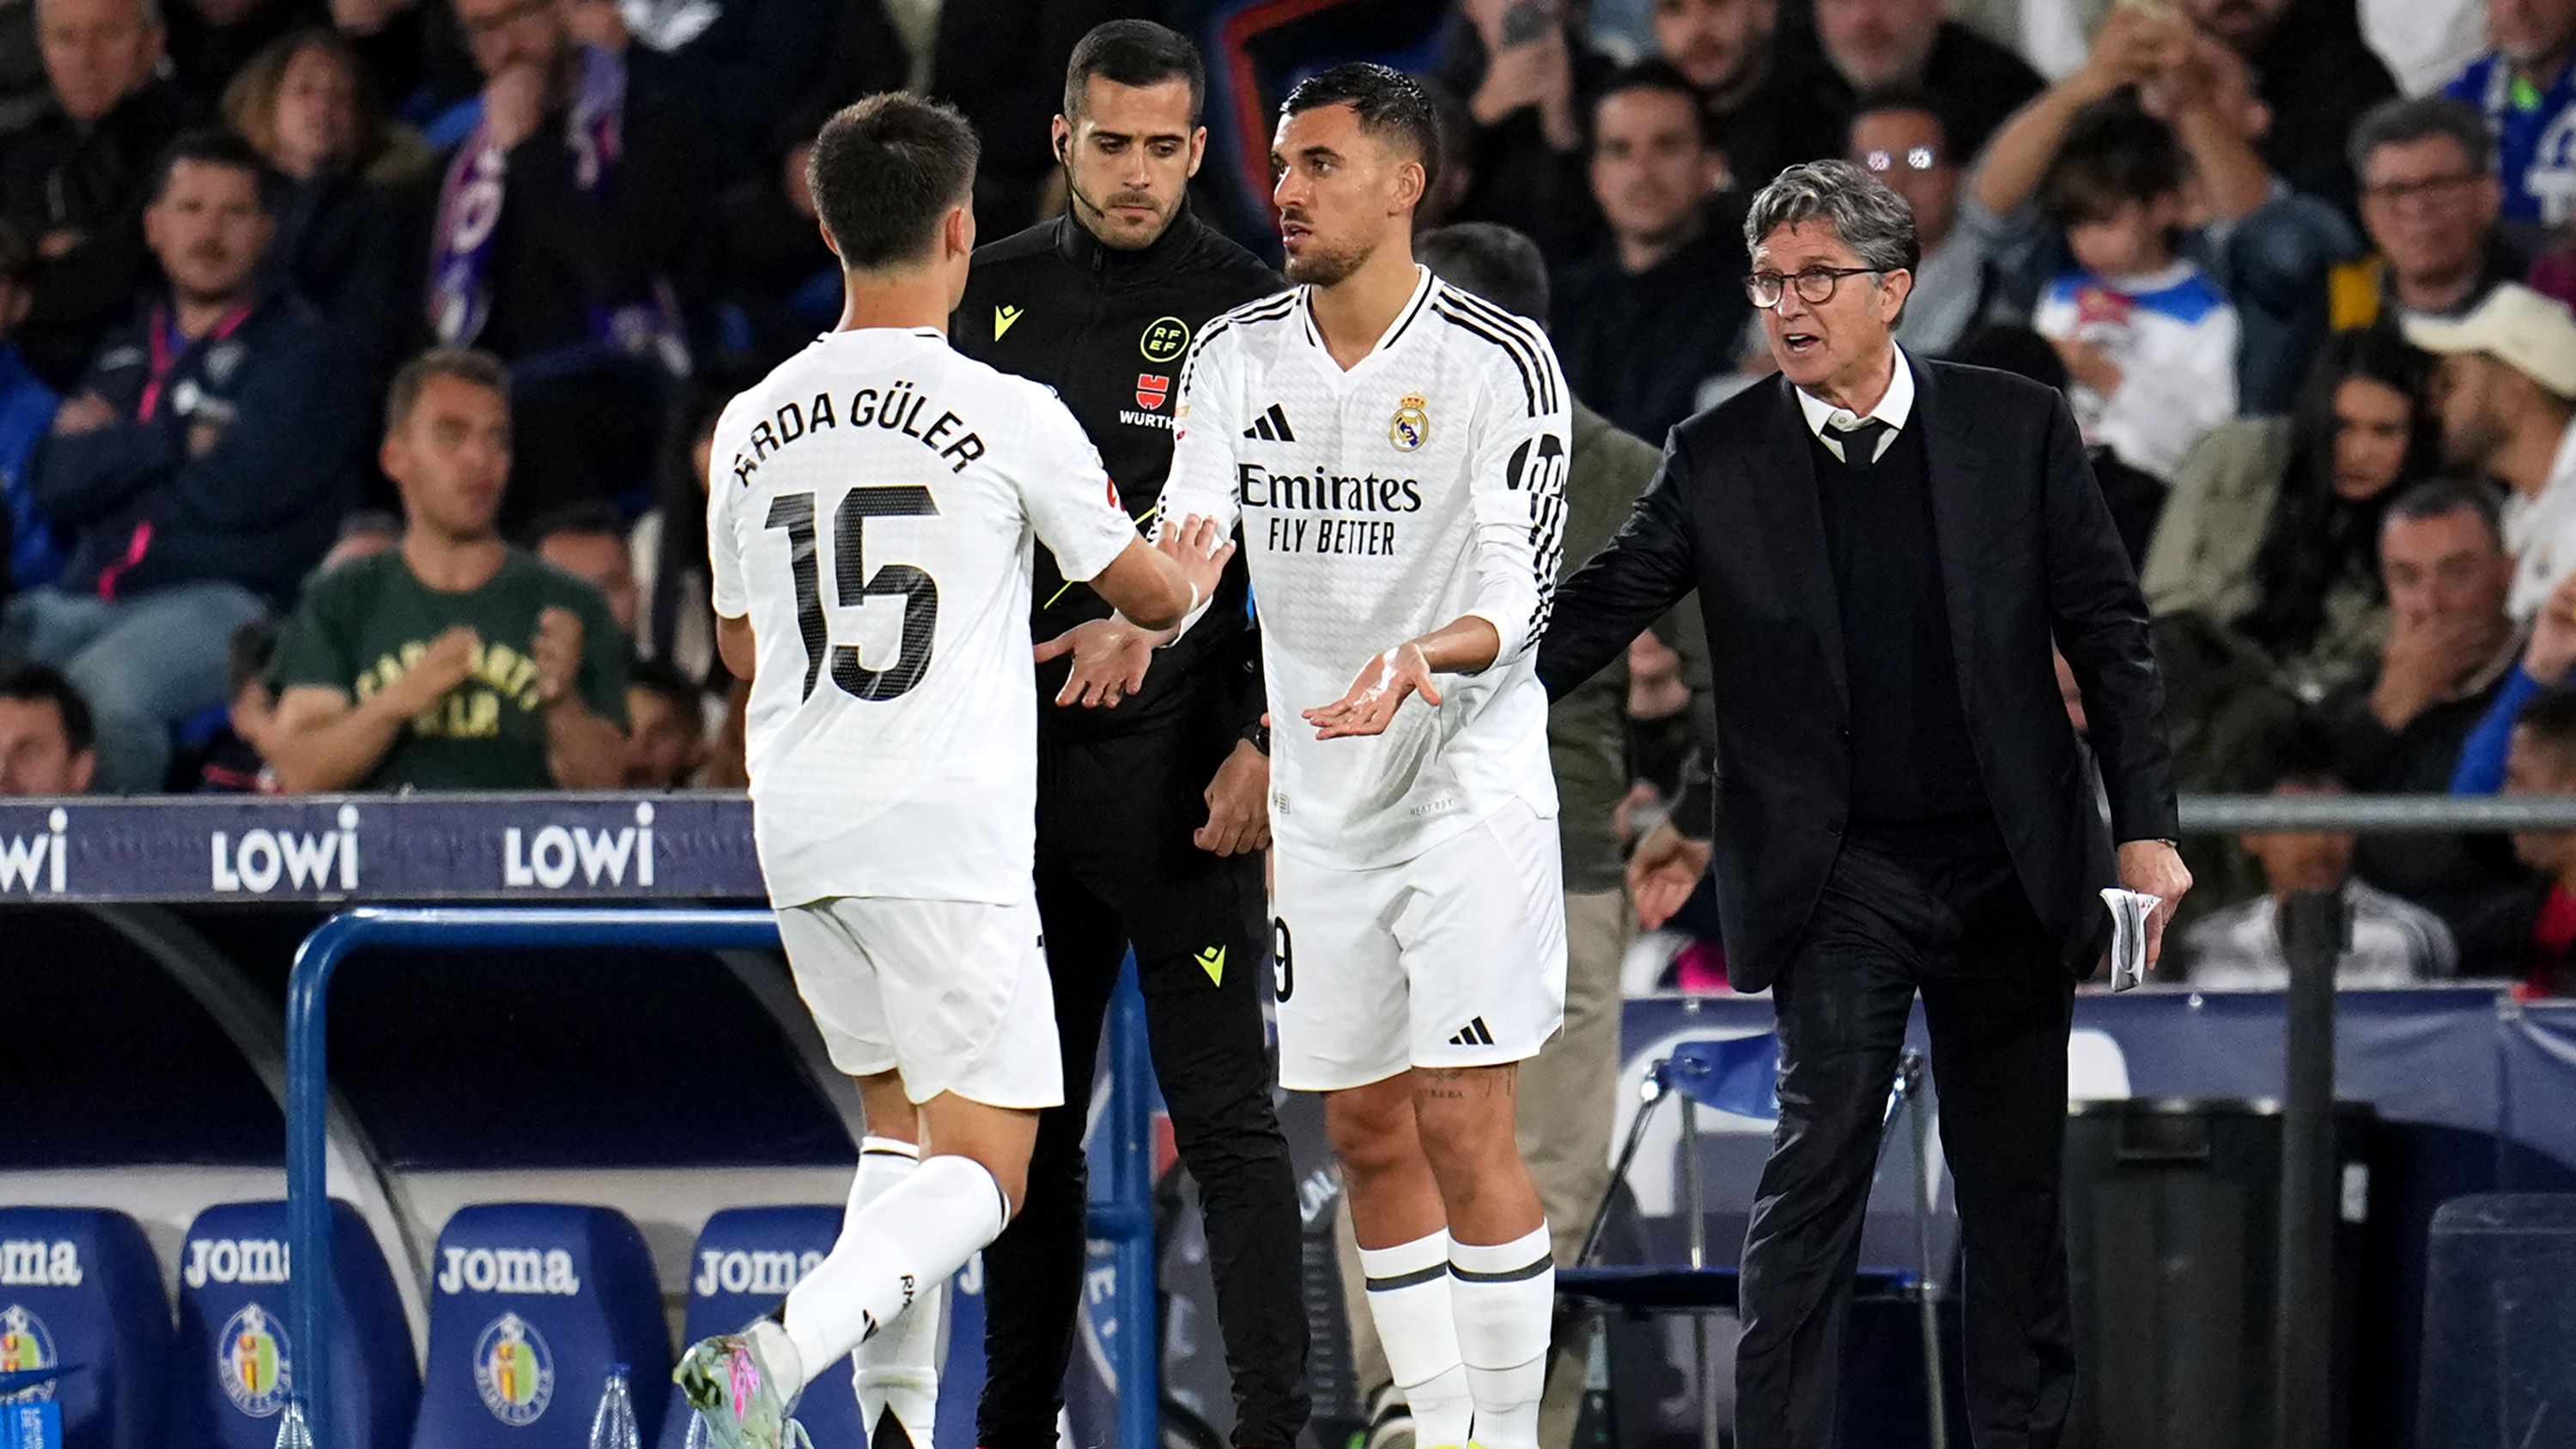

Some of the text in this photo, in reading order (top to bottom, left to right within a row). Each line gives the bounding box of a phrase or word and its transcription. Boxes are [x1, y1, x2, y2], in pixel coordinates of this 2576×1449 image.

[734, 380, 985, 488] ARDA GÜLER
[1237, 464, 1422, 512] Emirates
[1269, 518, 1395, 555] FLY BETTER
[764, 485, 940, 705] 15
[0, 1240, 83, 1286] ma
[185, 1239, 290, 1288] Jom
